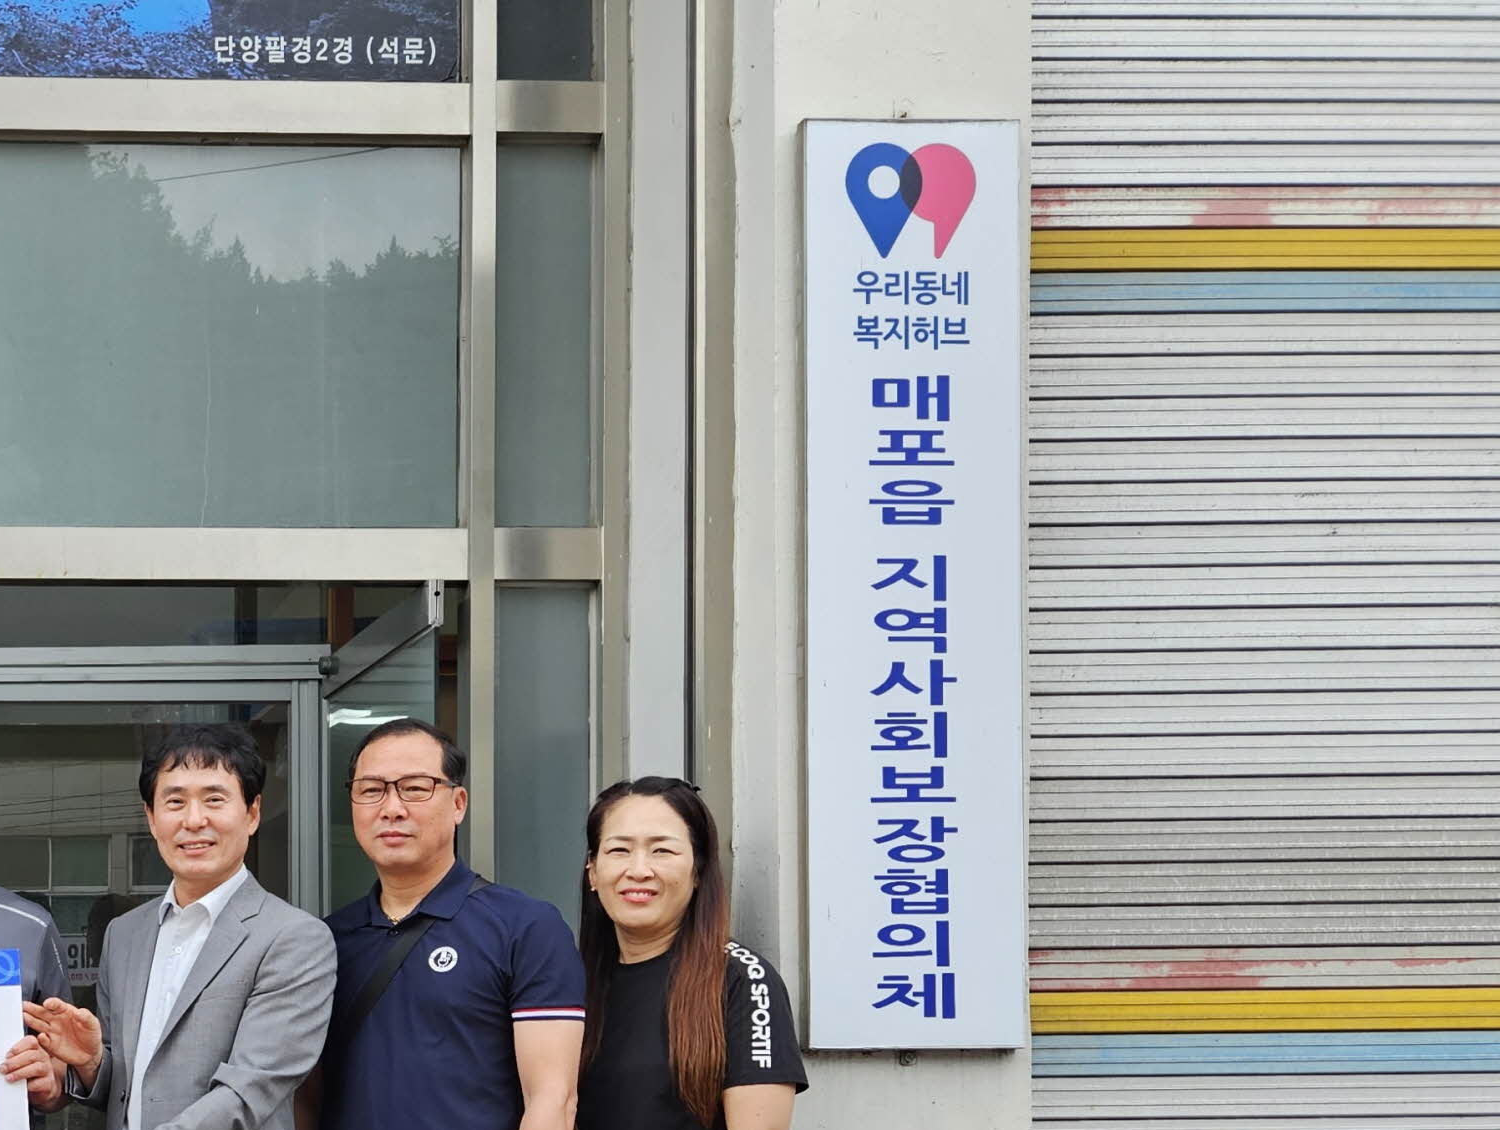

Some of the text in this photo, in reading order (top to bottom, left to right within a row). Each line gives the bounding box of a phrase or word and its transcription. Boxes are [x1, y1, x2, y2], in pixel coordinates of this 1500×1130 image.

[213, 35, 437, 66] 단양팔경2경 (석문)
[853, 270, 970, 307] 우리동네
[853, 313, 971, 351] 복지허브
[869, 375, 958, 1020] 매포읍 지역사회보장협의체
[750, 983, 772, 1069] SPORTIF
